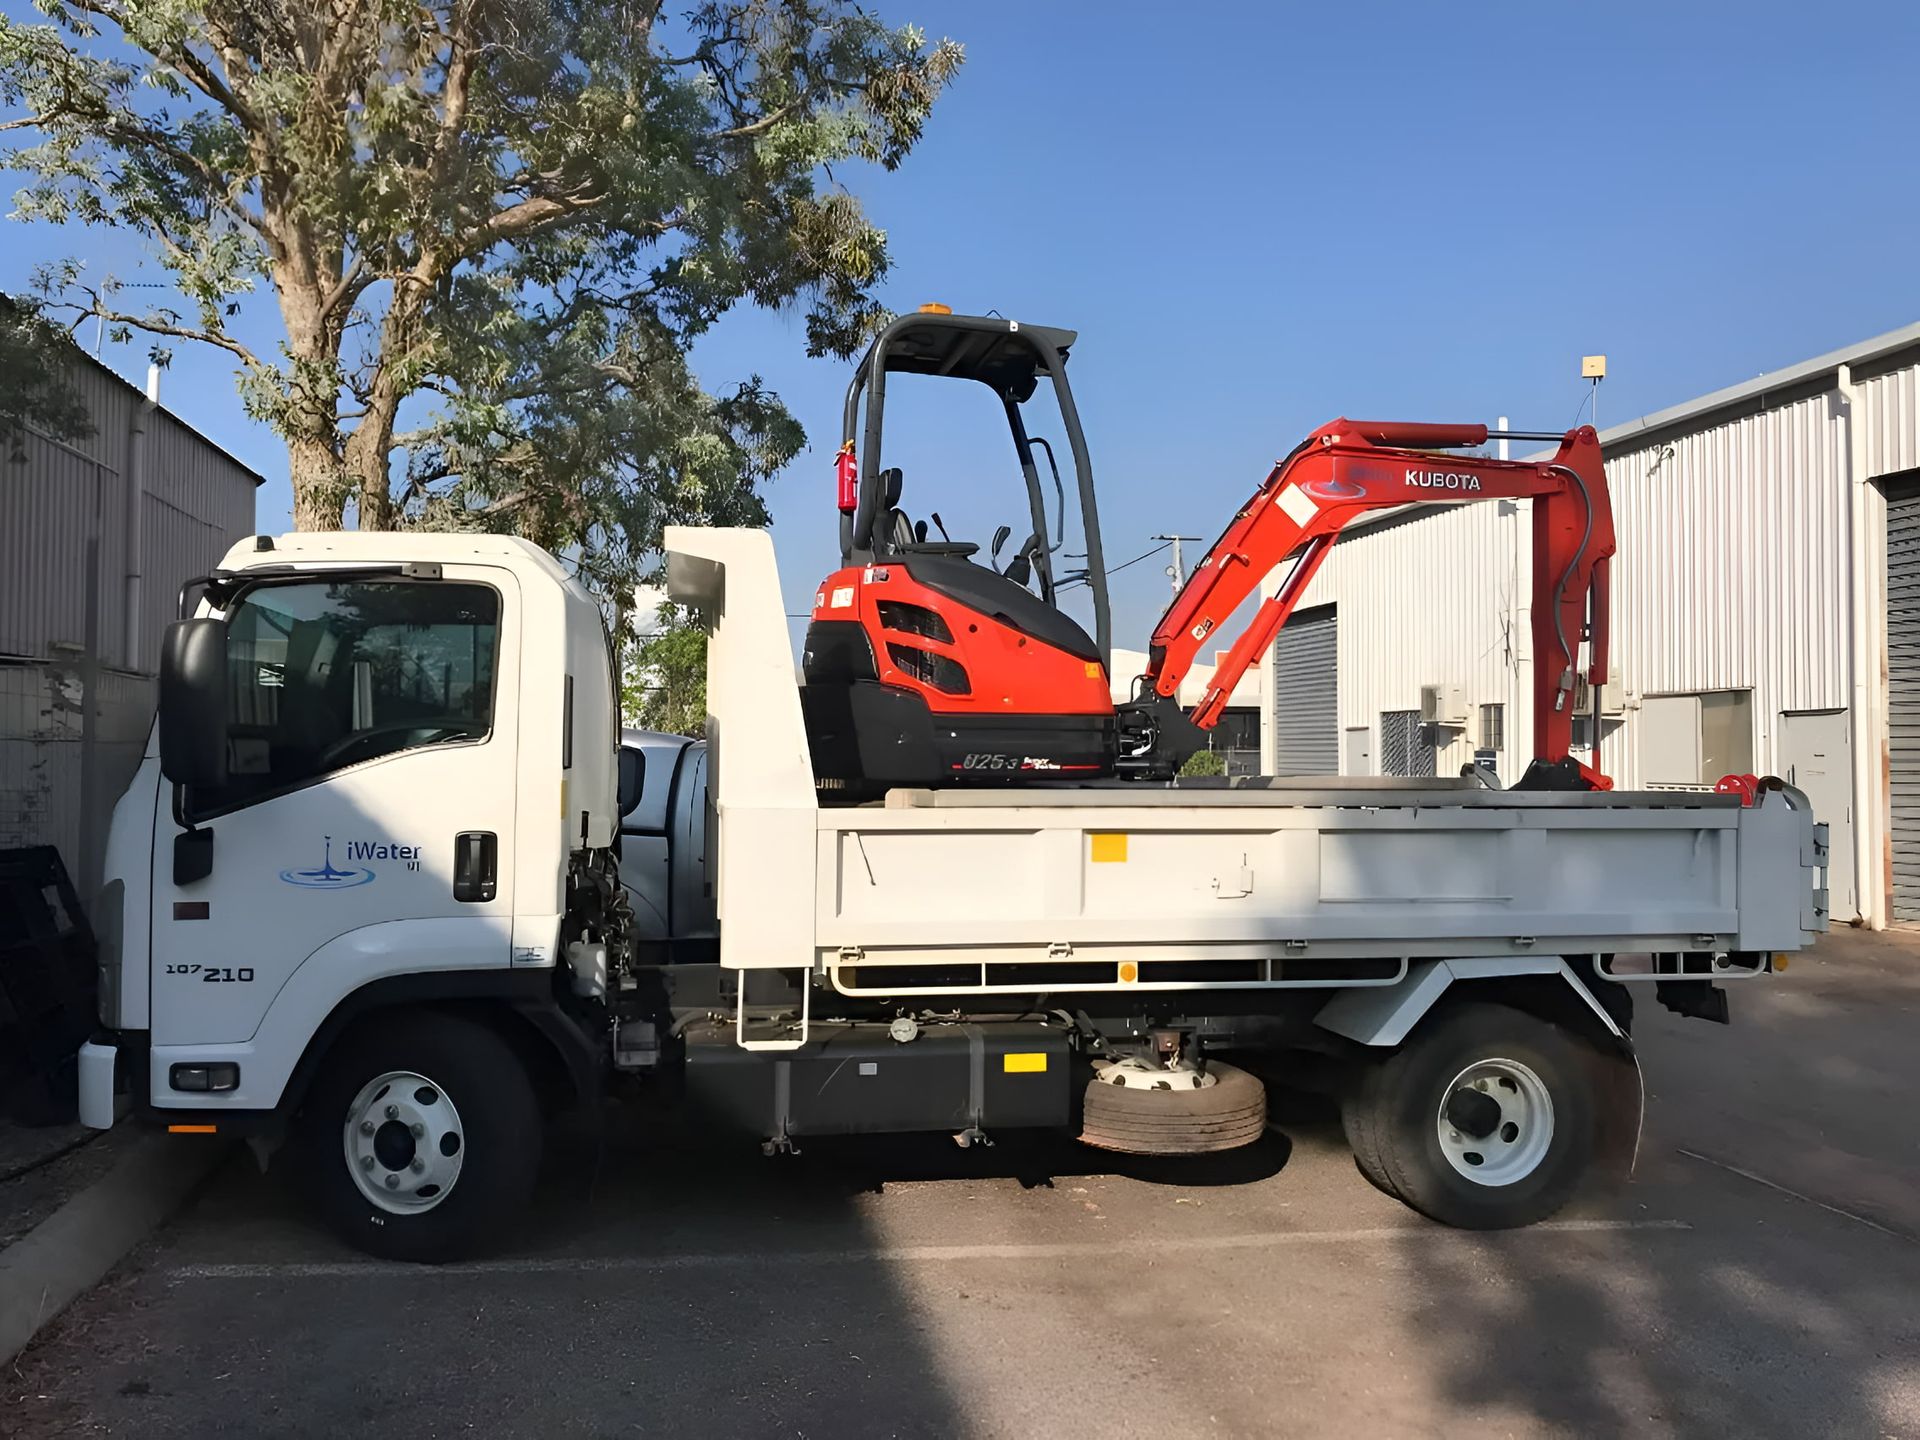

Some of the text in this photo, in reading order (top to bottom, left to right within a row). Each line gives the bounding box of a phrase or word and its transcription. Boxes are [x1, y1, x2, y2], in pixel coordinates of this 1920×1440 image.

[1405, 469, 1481, 491] KUBOTA
[347, 841, 422, 860] iWater
[203, 967, 254, 983] 210
